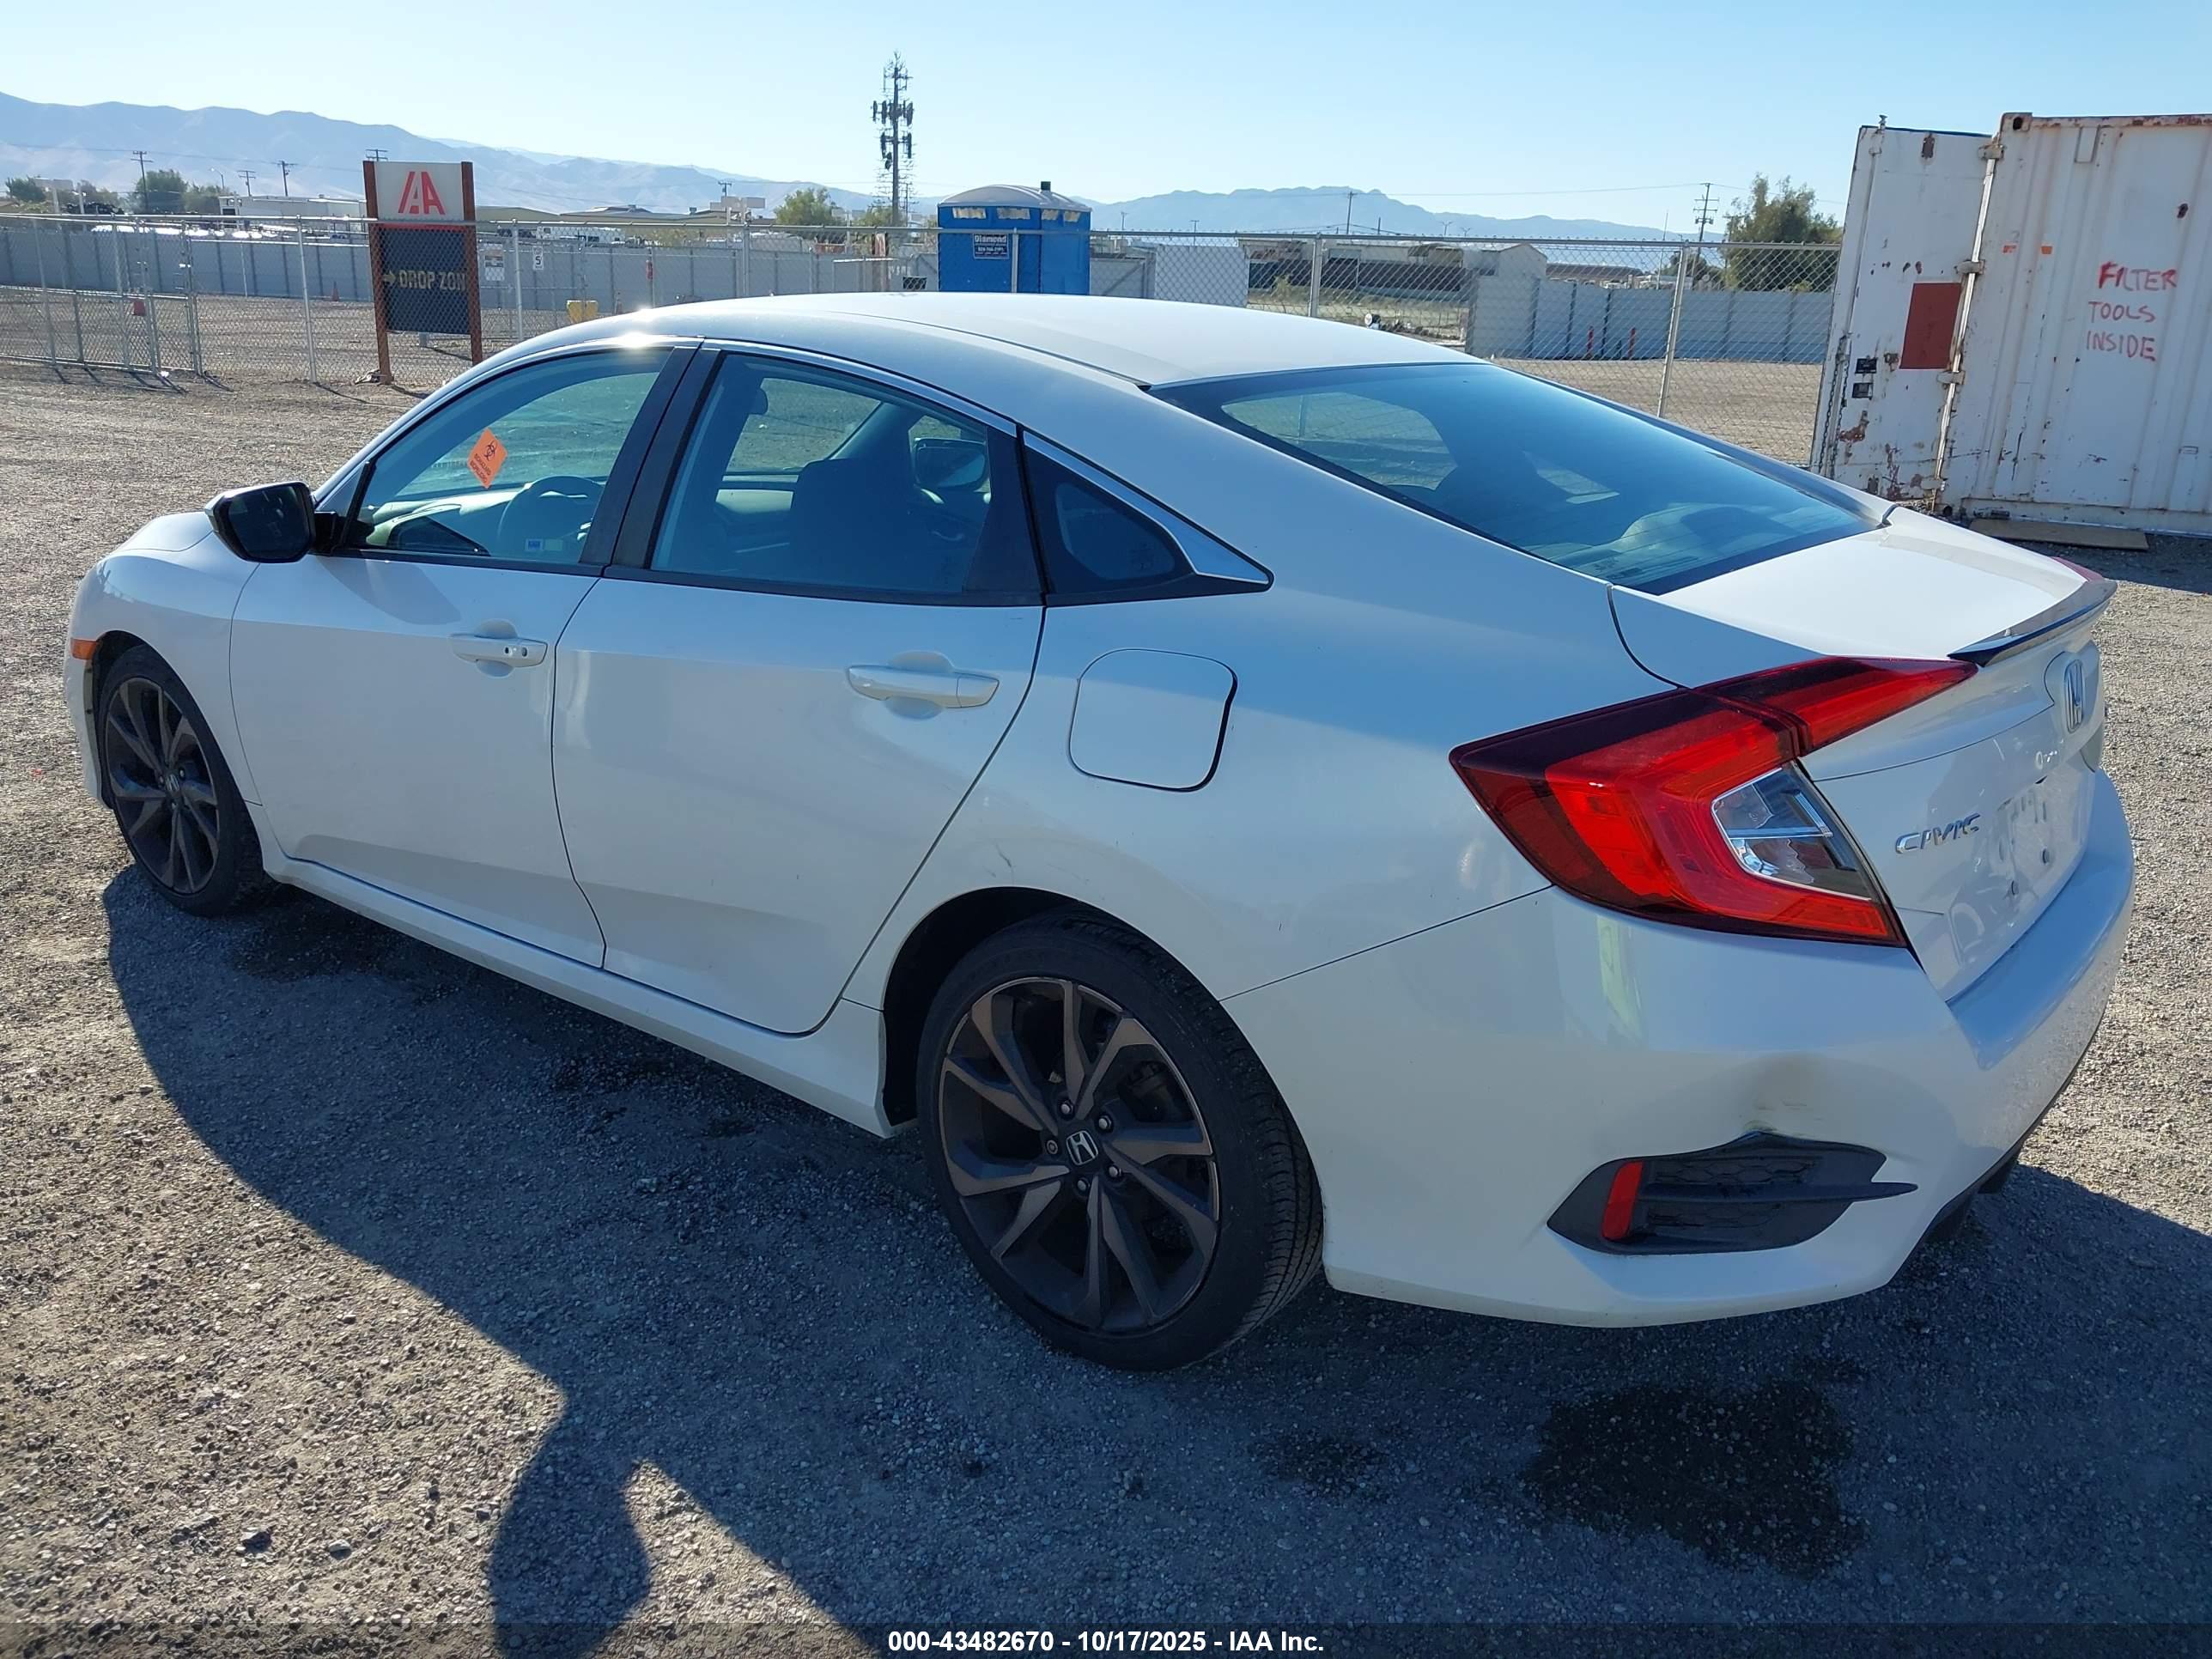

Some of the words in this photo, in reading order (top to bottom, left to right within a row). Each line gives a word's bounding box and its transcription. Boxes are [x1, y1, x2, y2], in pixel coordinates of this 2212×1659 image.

[975, 234, 1006, 243] Diamond
[398, 270, 435, 289] DROP
[439, 271, 467, 291] ZON
[2099, 262, 2177, 291] FILTER
[2088, 301, 2156, 323] TOOLS
[2087, 331, 2156, 362] INSIDE
[1895, 812, 1981, 854] CIVIC
